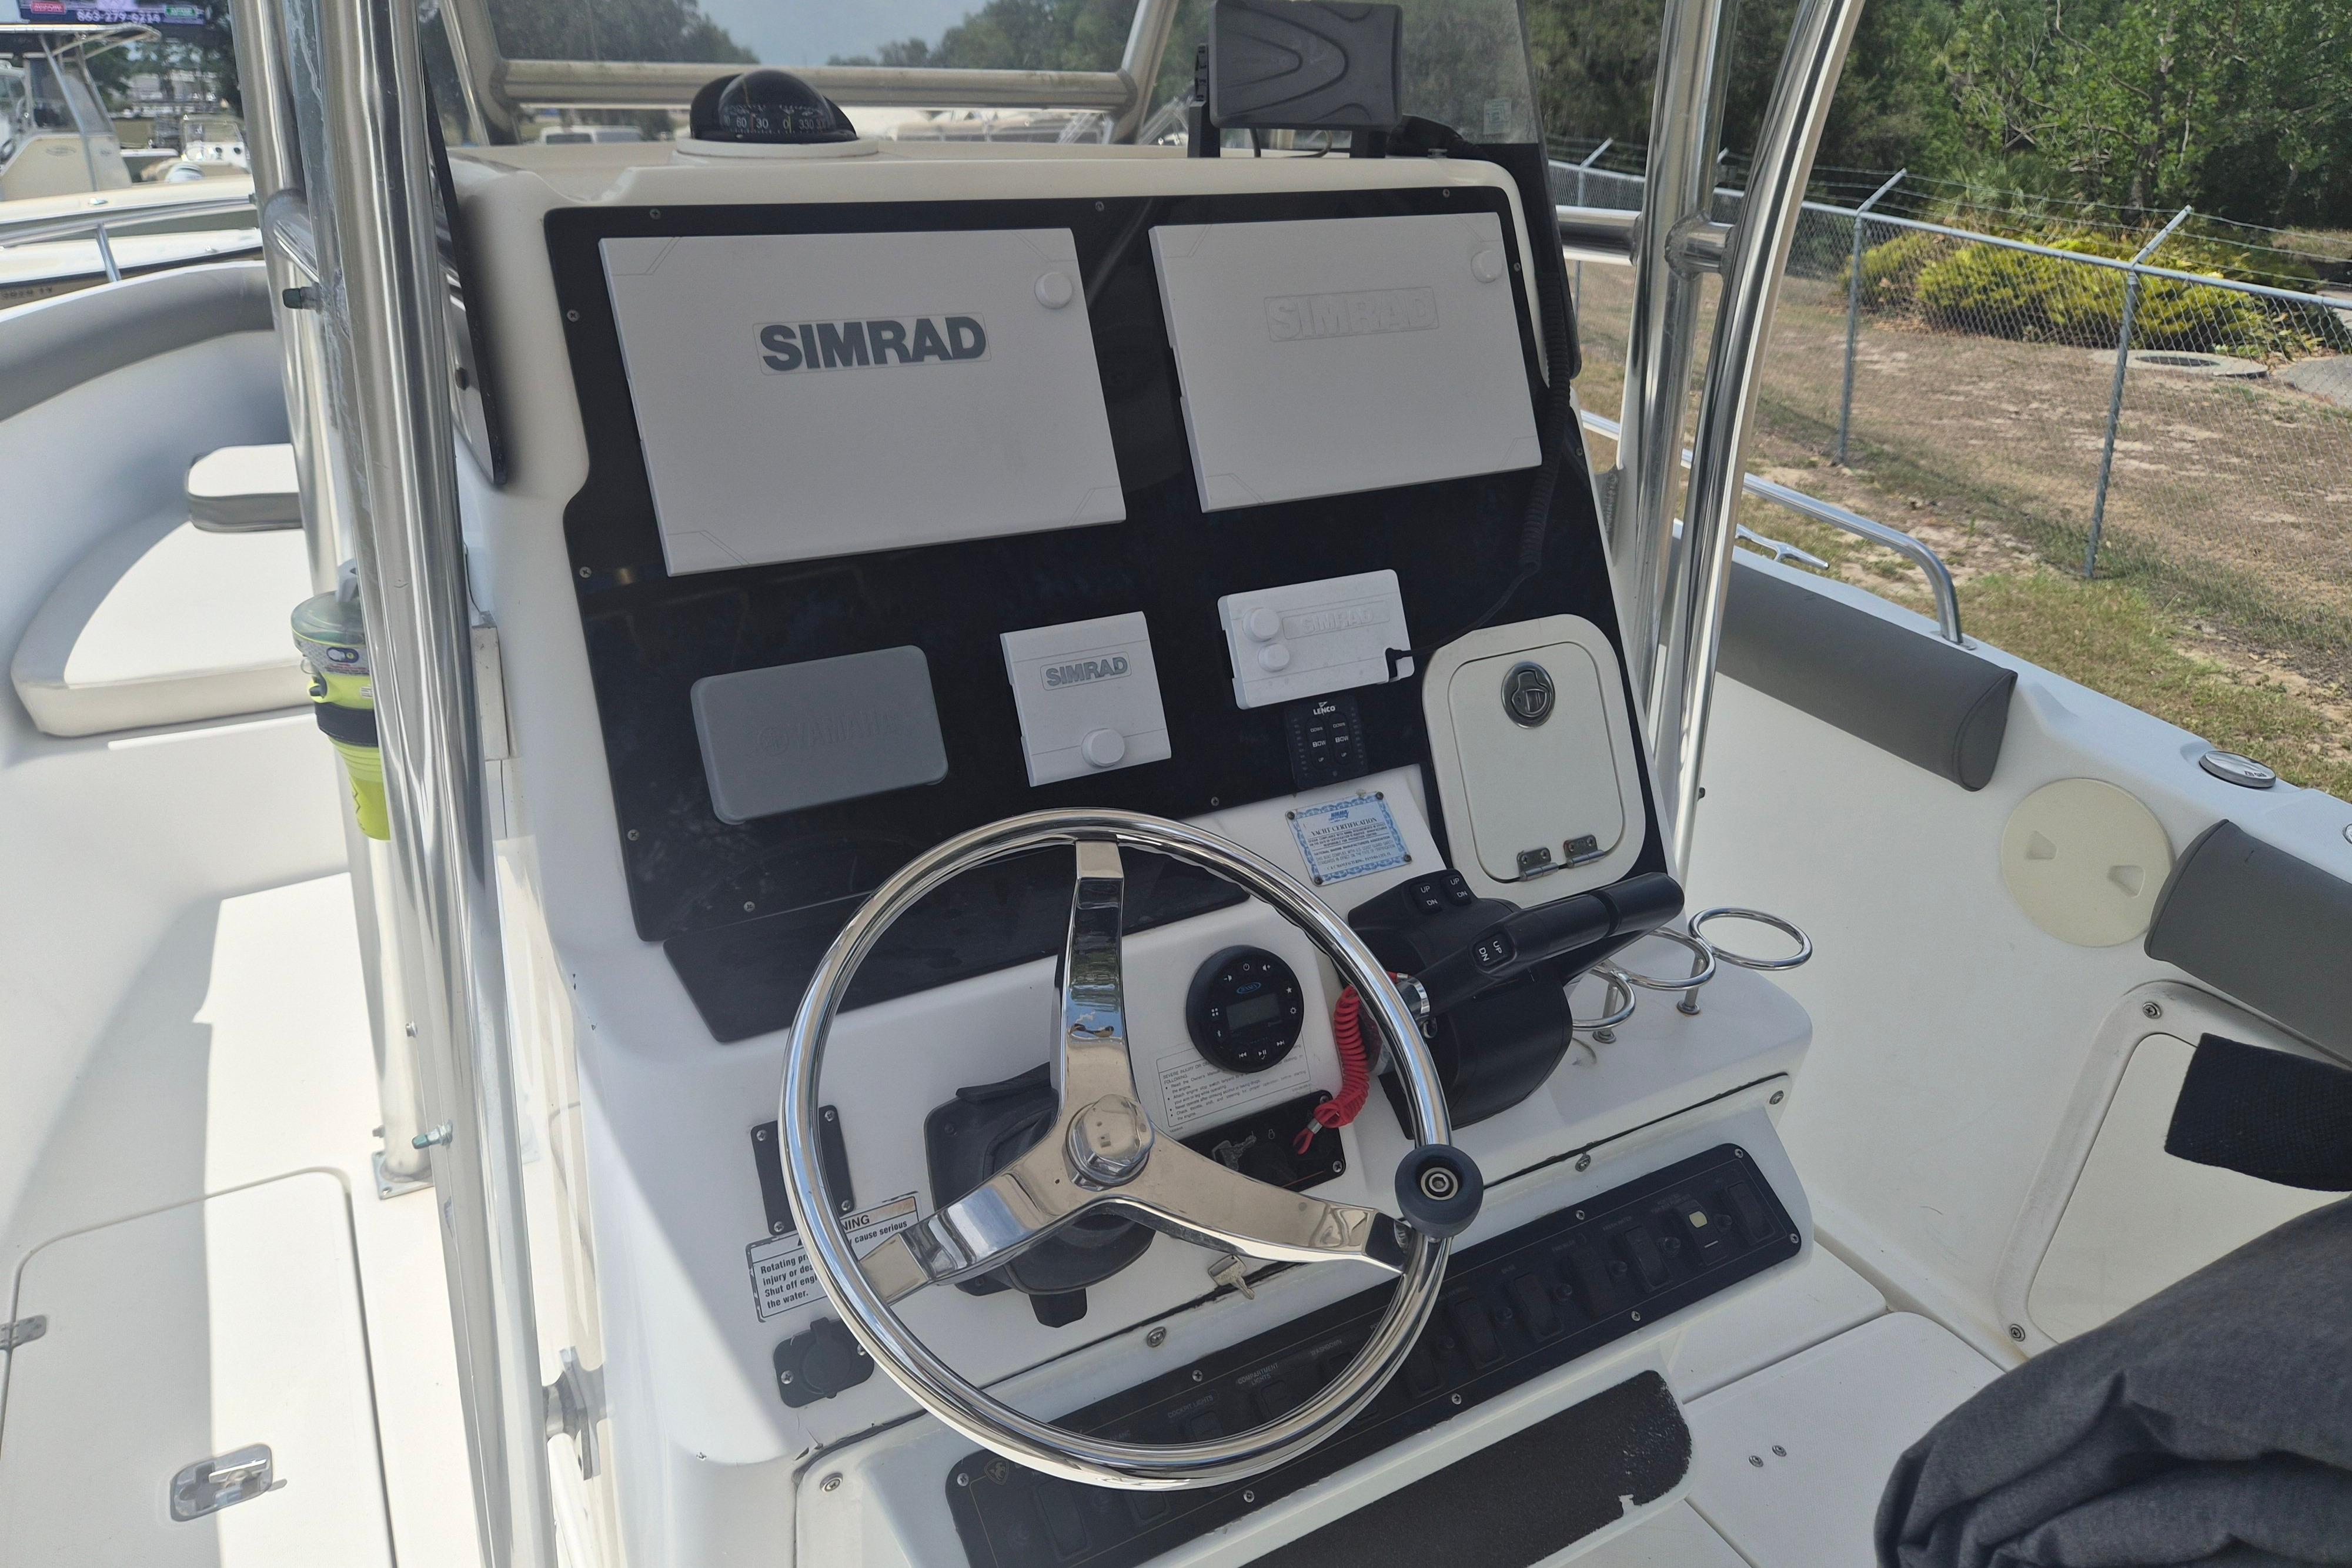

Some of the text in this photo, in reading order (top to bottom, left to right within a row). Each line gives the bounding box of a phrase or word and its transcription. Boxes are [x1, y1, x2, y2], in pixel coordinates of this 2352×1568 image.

[736, 117, 747, 128] 60
[756, 118, 769, 129] 30
[799, 119, 814, 129] 330
[760, 316, 986, 371] SIMRAD
[1045, 657, 1128, 686] SIMRAD
[1313, 706, 1335, 715] LENCO
[1311, 817, 1377, 837] YACHT CERTIFICATION
[1479, 947, 1490, 962] DN
[1493, 941, 1502, 954] UP
[760, 1258, 796, 1275] Rotating
[854, 1231, 877, 1243] cause
[879, 1221, 907, 1235] serious
[789, 1269, 797, 1278] or
[765, 1285, 784, 1298] Shut
[786, 1280, 797, 1290] off
[767, 1290, 808, 1309] the water.
[1310, 1339, 1342, 1356] WASHDOWN
[1237, 1363, 1279, 1385] COMPARTMENT
[1251, 1373, 1271, 1386] LIGHTS
[1167, 1394, 1214, 1418] COCKPIT LIGHTS
